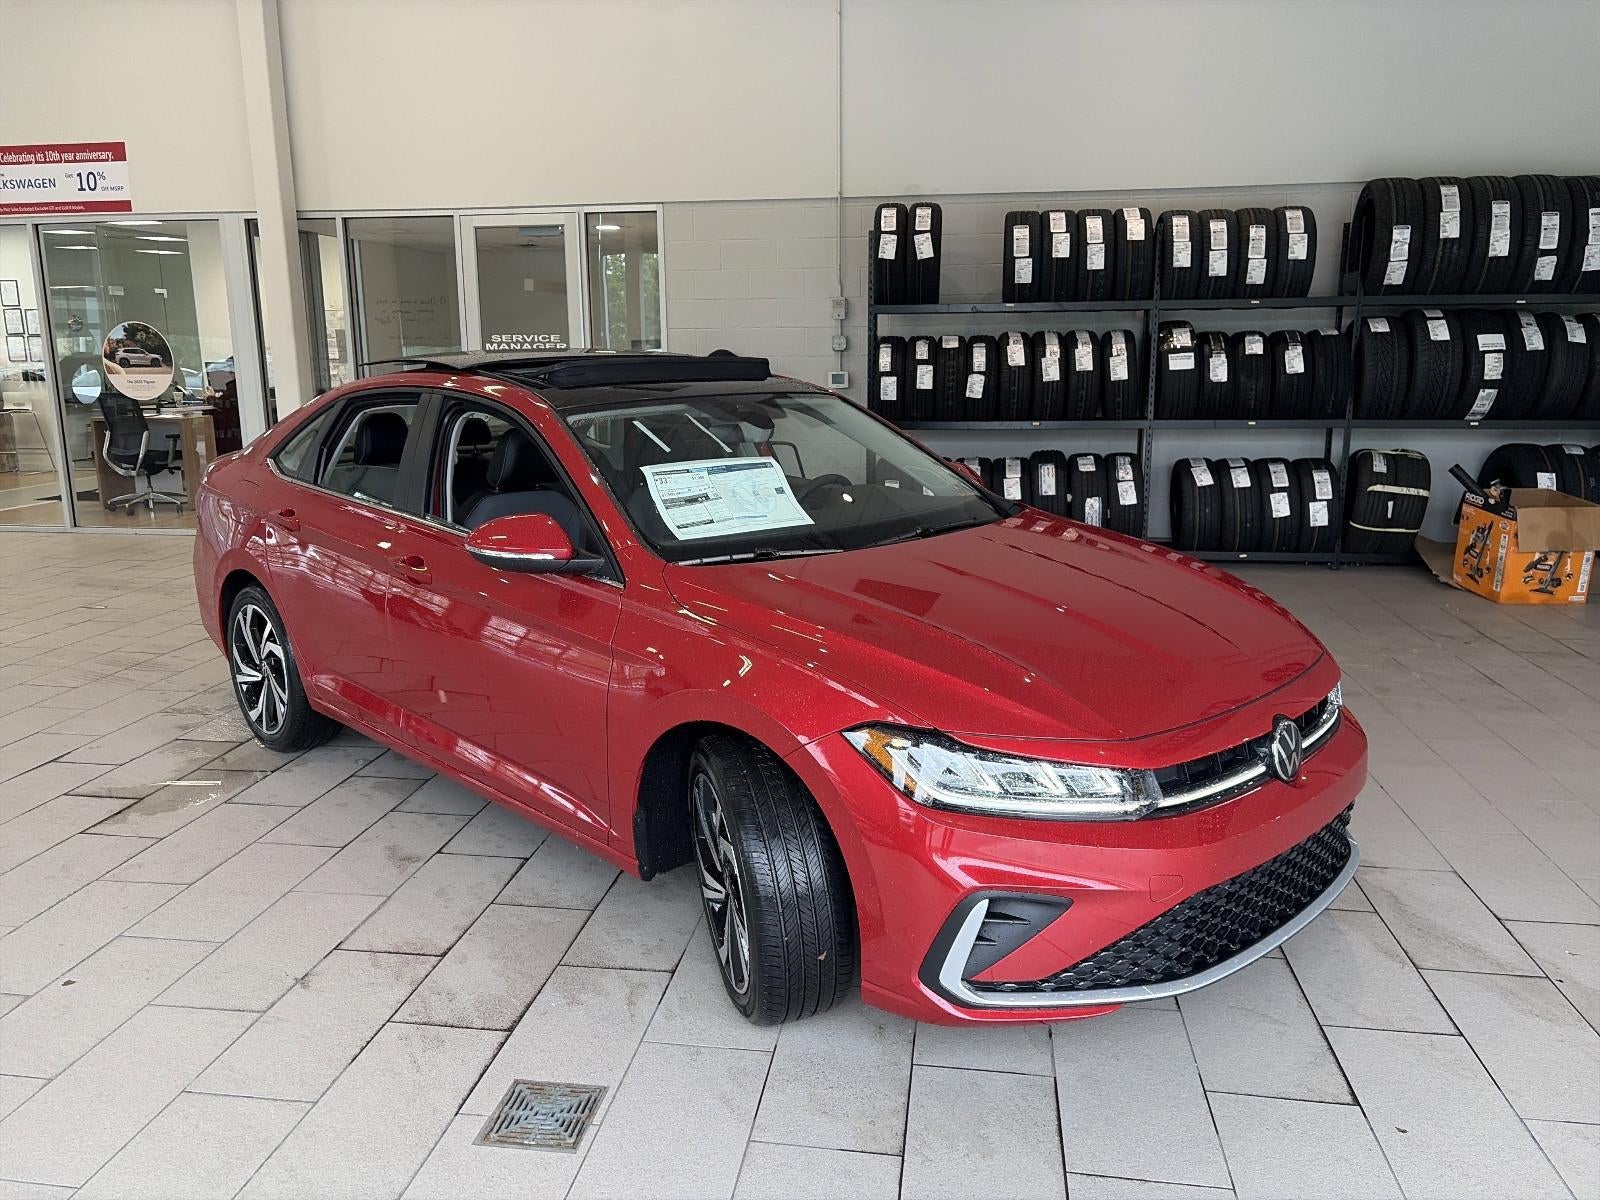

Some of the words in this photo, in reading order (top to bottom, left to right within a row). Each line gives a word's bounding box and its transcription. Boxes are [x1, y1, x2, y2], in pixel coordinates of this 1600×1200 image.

[0, 151, 35, 164] Celebrating
[36, 151, 45, 162] its
[45, 150, 60, 162] 10th
[60, 152, 74, 164] year
[75, 149, 114, 162] anniversary.
[491, 334, 561, 342] SERVICE
[485, 342, 567, 350] MANAGER
